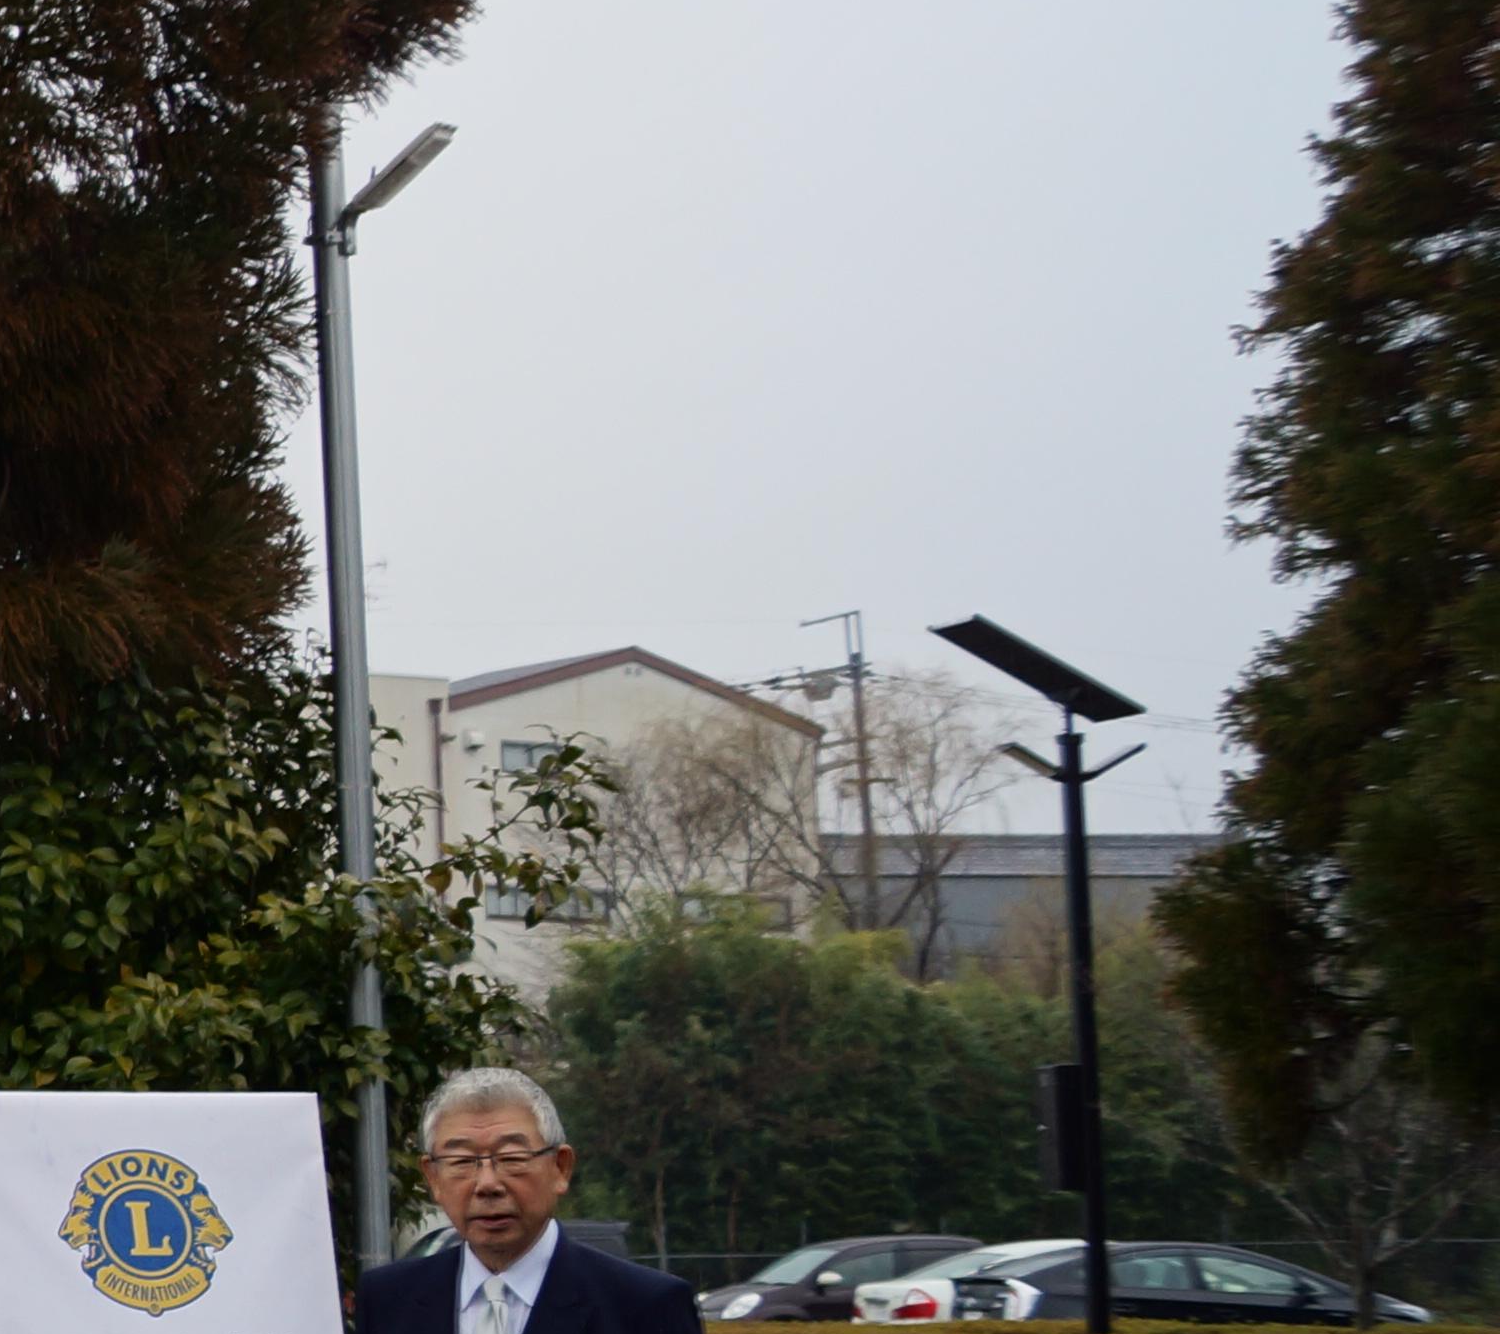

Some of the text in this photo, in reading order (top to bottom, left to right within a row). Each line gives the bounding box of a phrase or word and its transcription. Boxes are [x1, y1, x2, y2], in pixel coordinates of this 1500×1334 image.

[91, 1155, 189, 1192] LIONS
[124, 1200, 174, 1257] L
[102, 1271, 201, 1303] INTERNATIONAL
